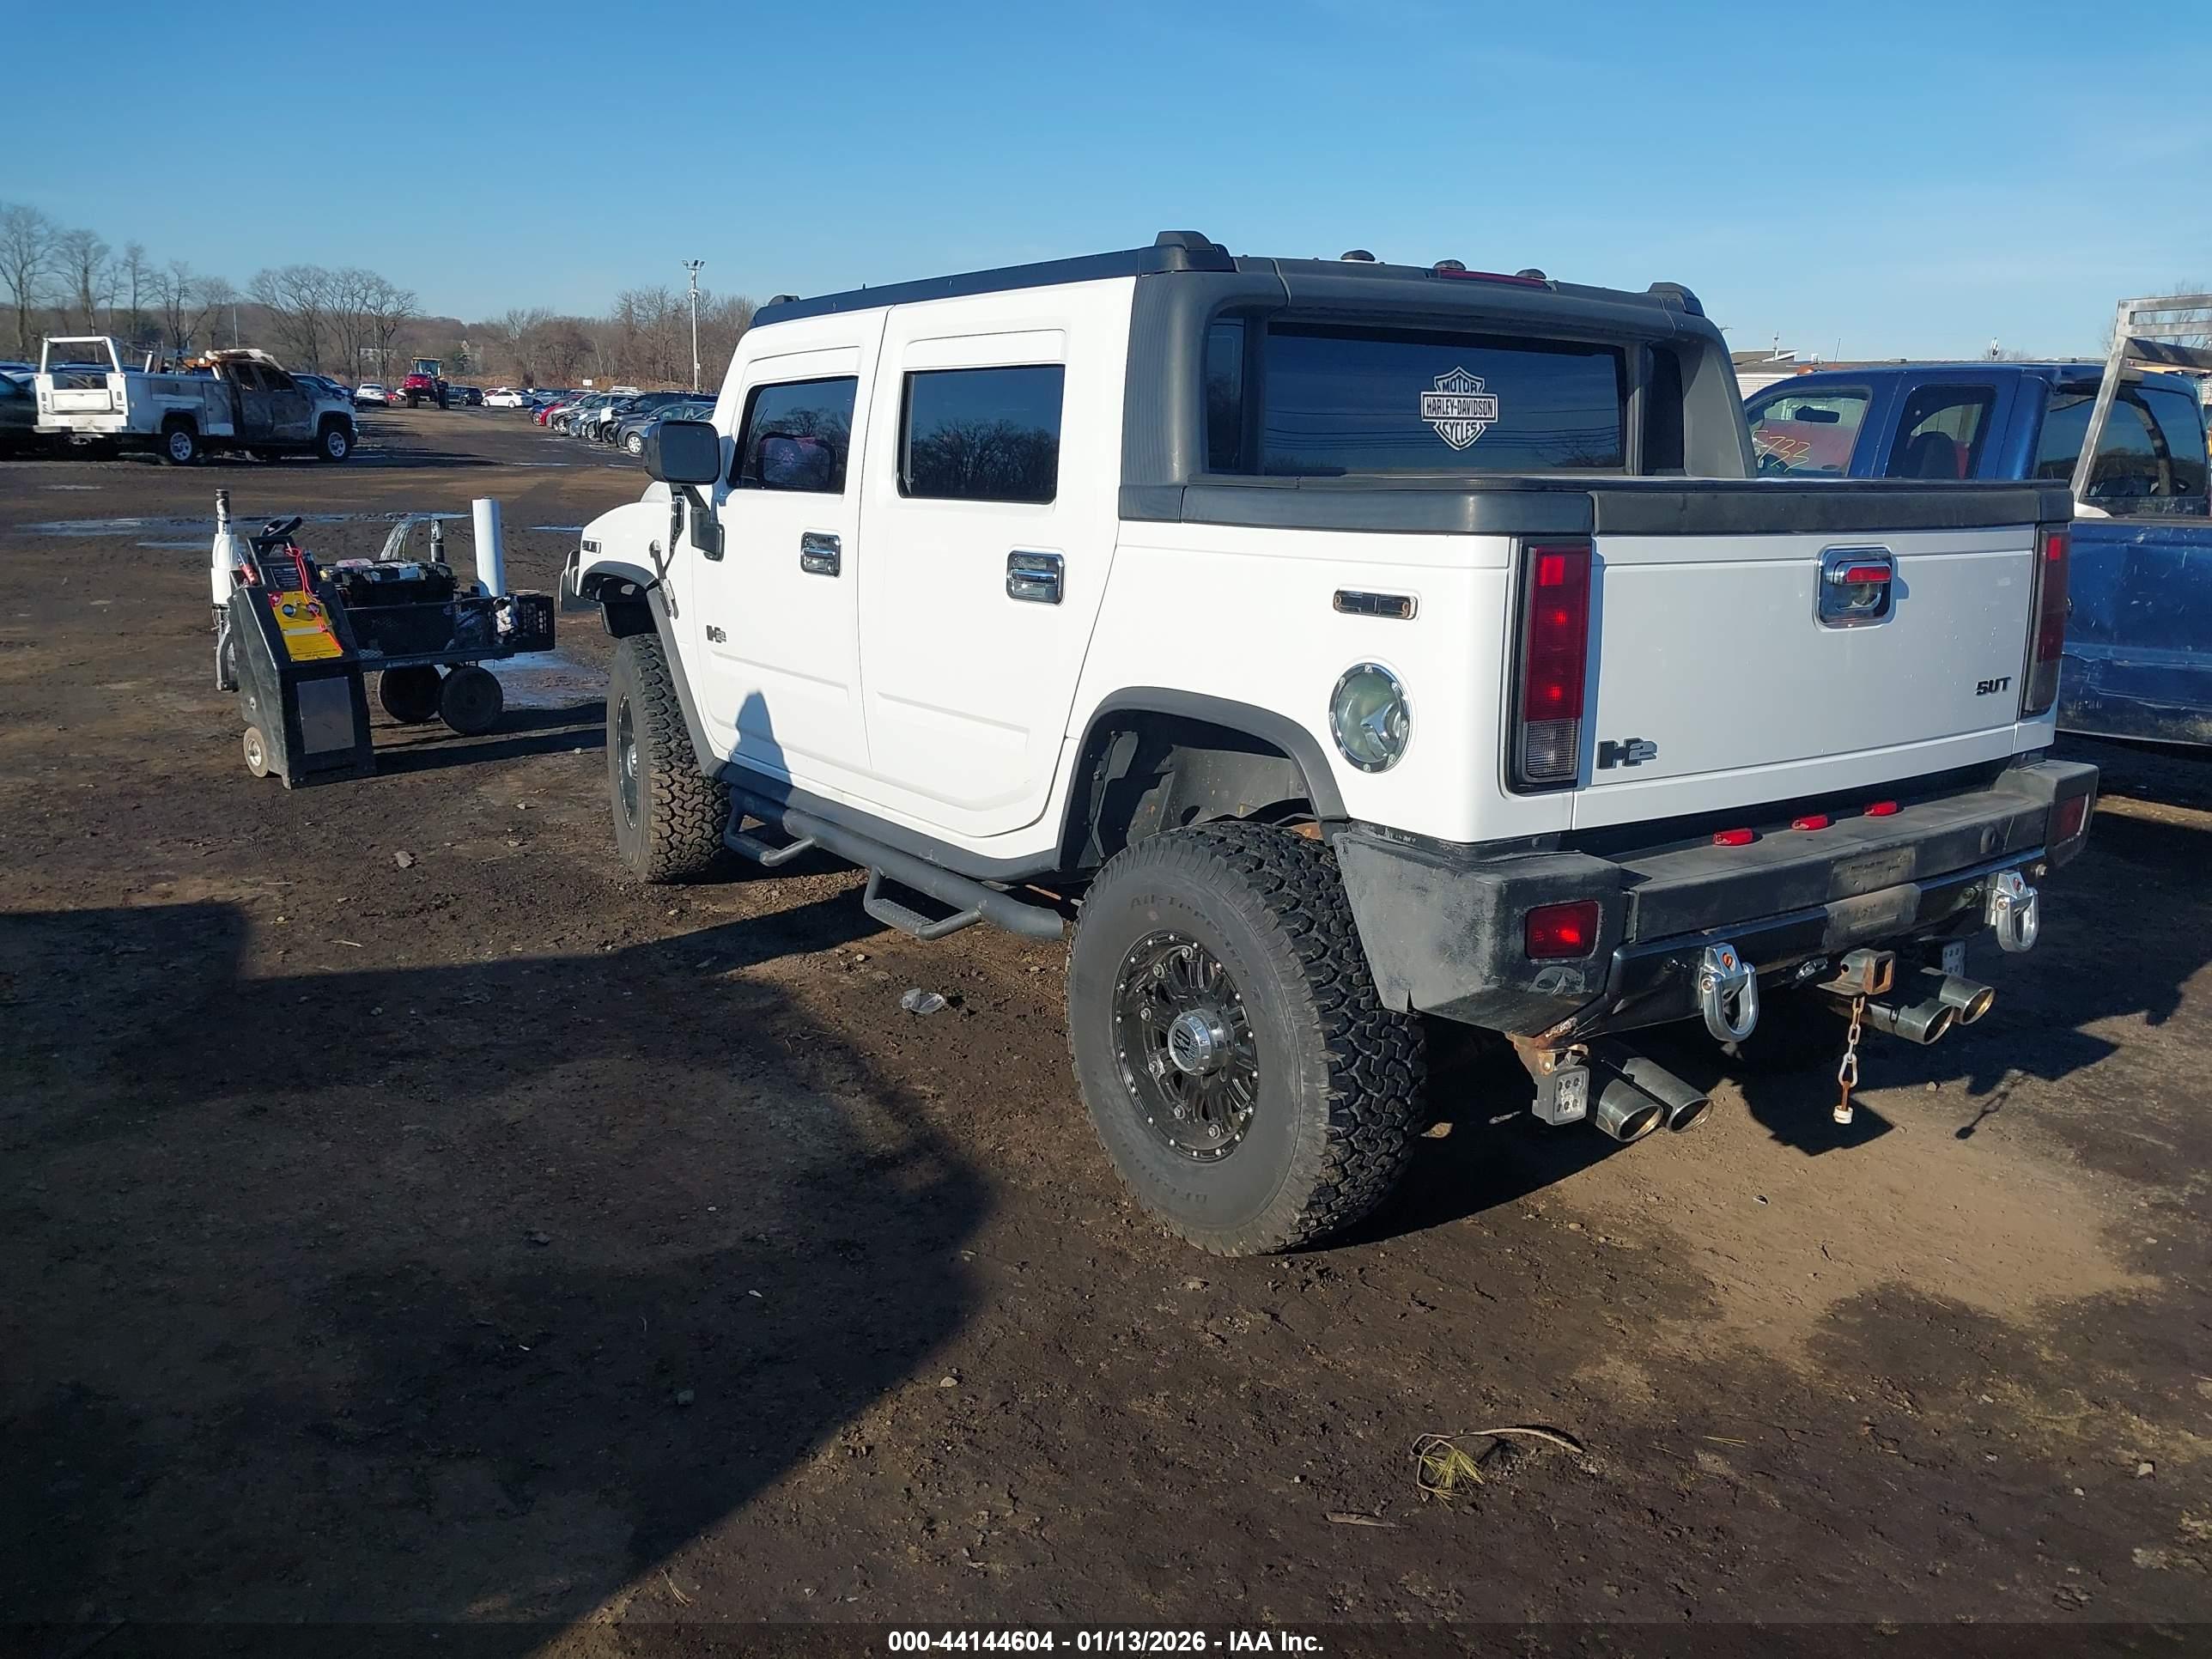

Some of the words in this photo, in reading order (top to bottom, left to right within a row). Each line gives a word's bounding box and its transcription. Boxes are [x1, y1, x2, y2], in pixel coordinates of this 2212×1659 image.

[1442, 376, 1478, 394] MOTOR
[1425, 397, 1493, 416] HARLEY-DAVIDSON
[1443, 421, 1477, 442] CYCLES
[706, 624, 726, 643] H2
[1596, 737, 1657, 769] H2
